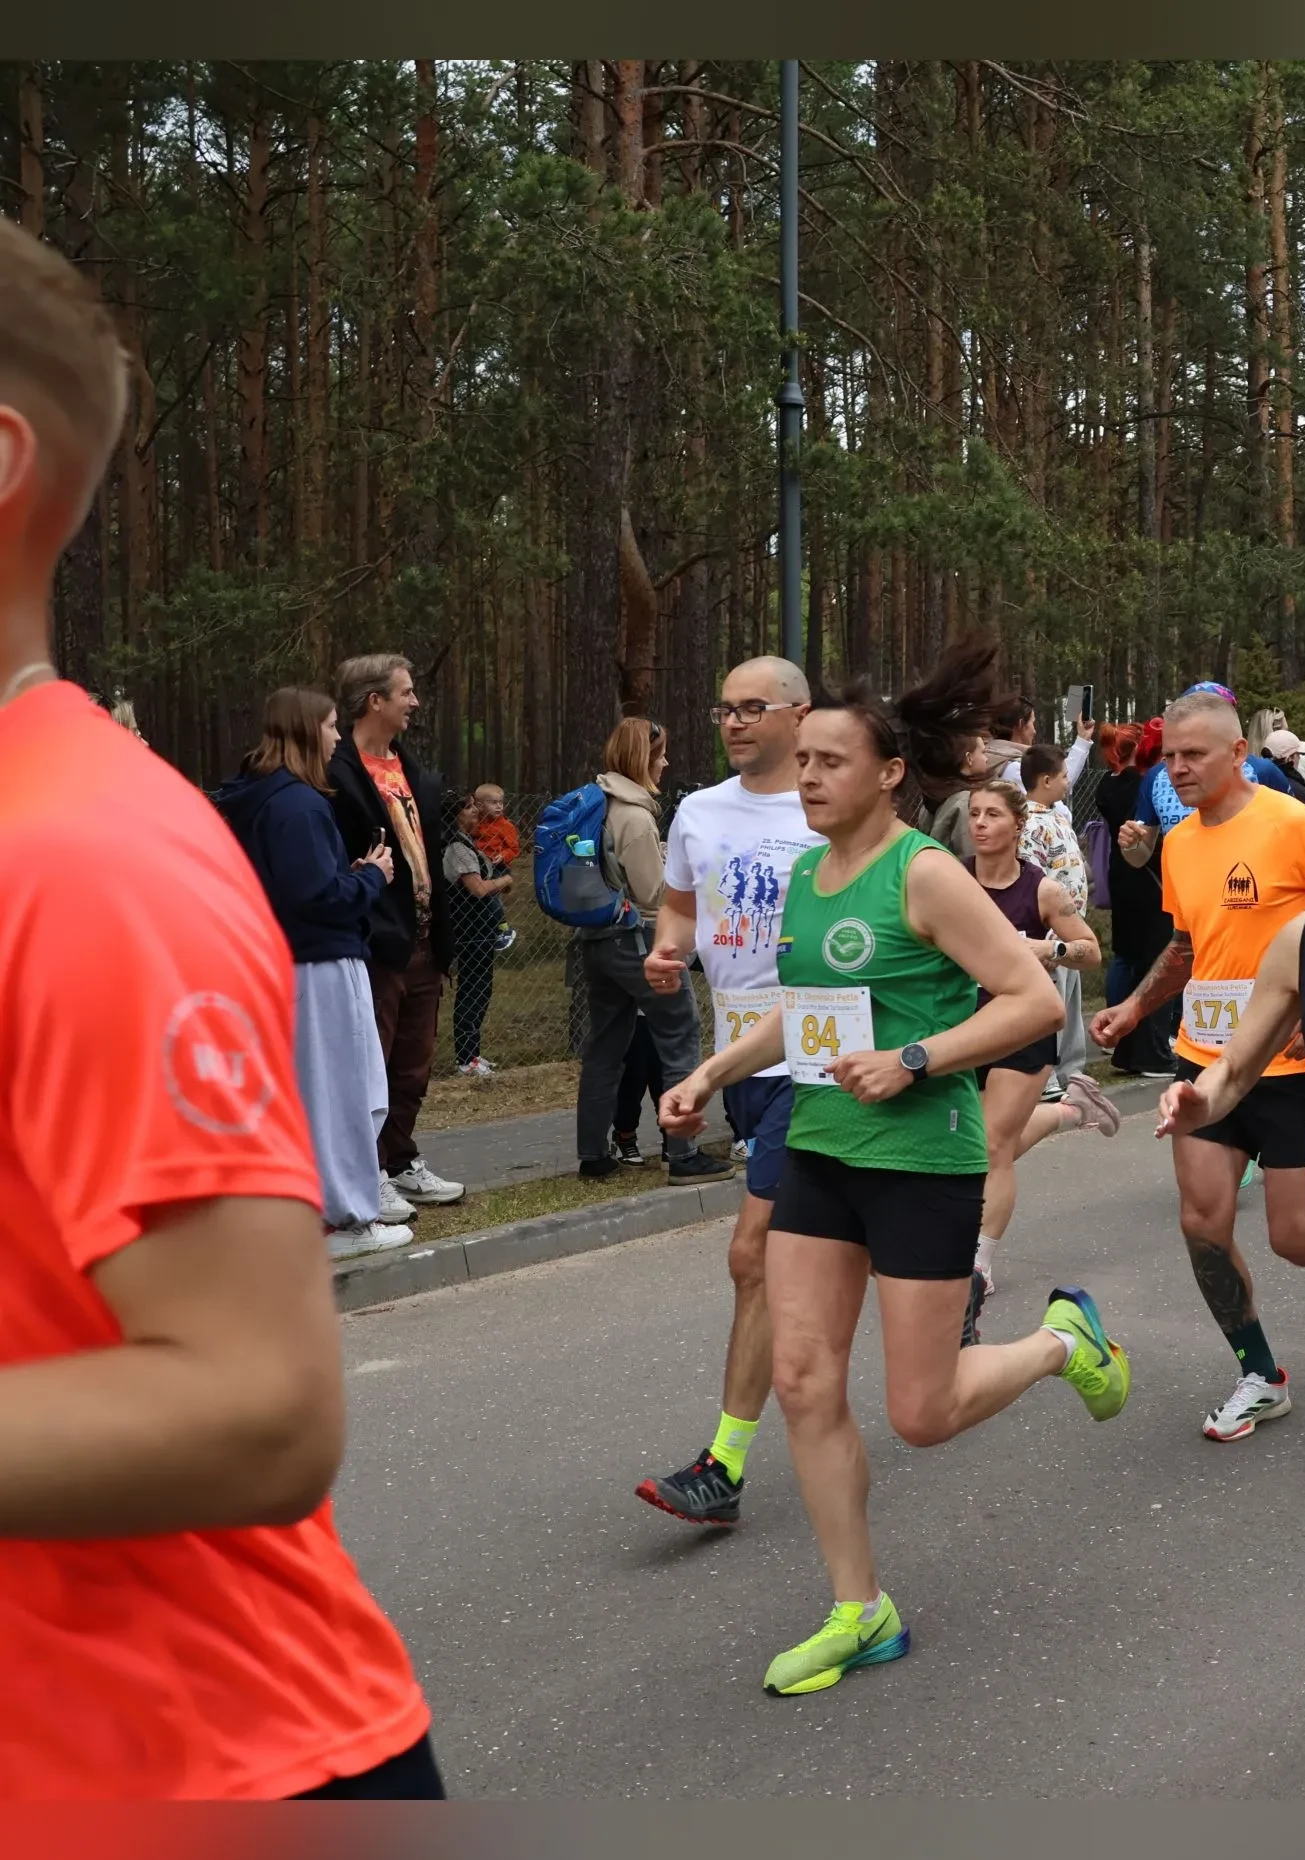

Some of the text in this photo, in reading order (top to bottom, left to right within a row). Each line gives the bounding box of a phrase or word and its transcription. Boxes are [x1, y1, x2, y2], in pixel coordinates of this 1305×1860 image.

[713, 934, 744, 947] 2018
[1191, 1000, 1239, 1029] 171
[801, 1014, 841, 1056] 84
